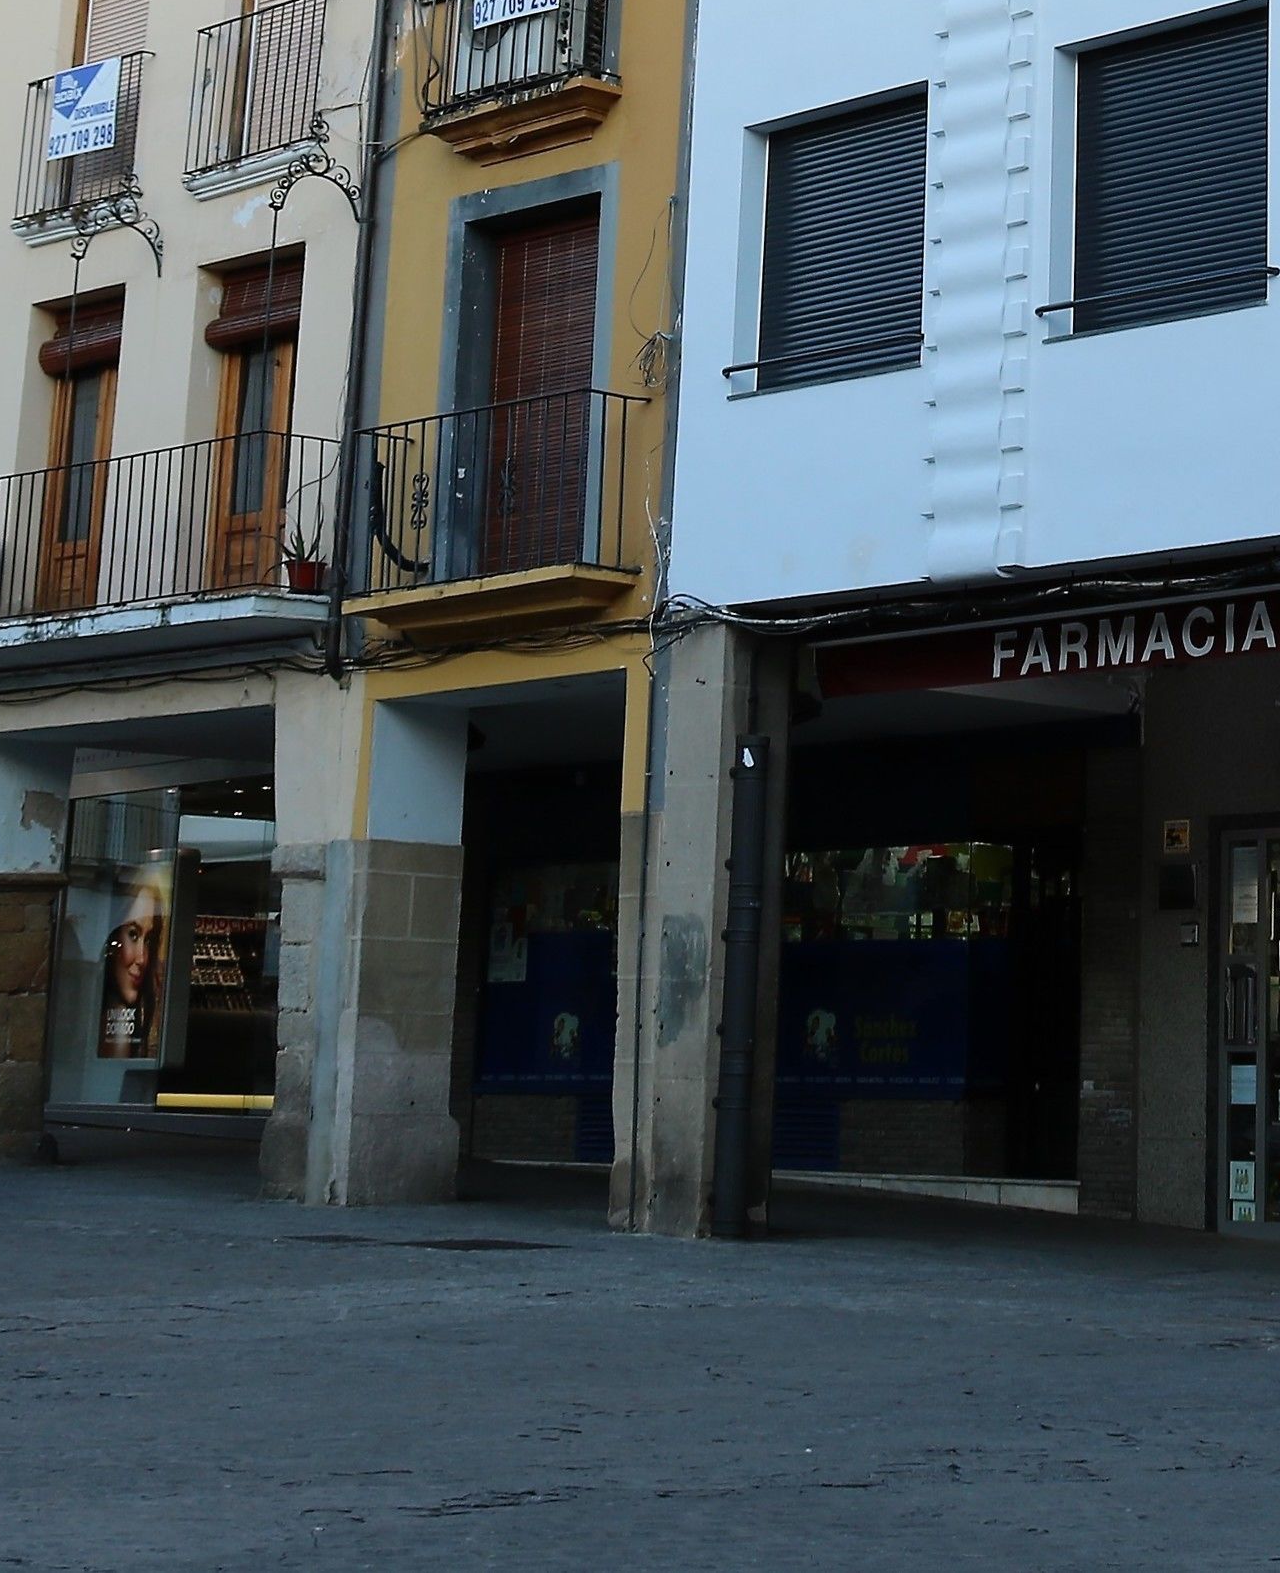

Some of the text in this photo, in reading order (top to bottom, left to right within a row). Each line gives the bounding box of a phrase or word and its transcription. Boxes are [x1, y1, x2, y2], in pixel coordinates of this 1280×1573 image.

[74, 99, 115, 120] DISPONIBLE
[49, 123, 113, 157] 927 709 298
[992, 600, 1277, 679] FARMACIA
